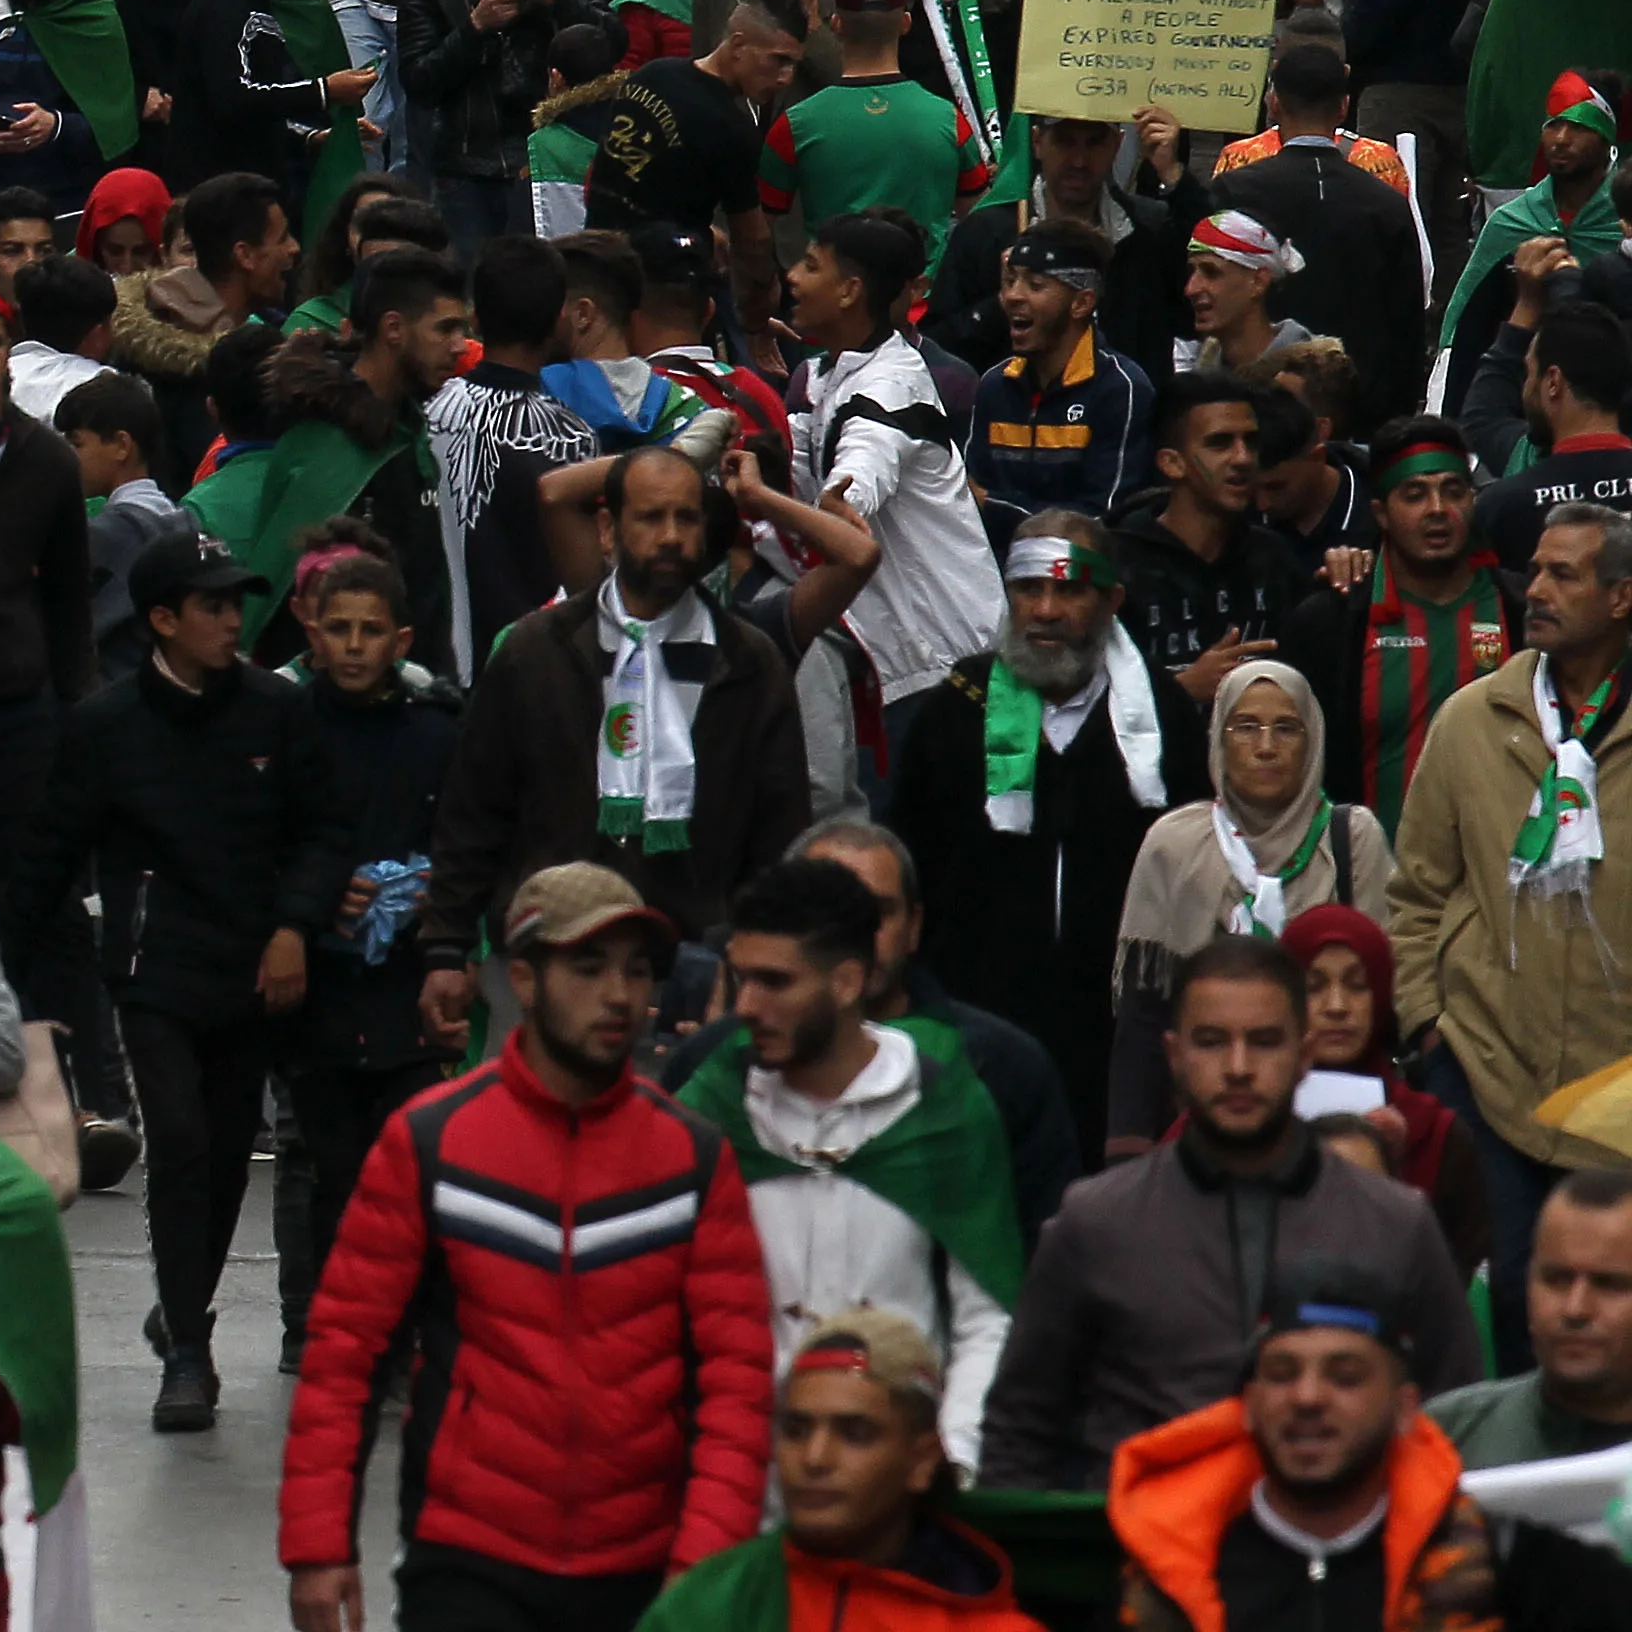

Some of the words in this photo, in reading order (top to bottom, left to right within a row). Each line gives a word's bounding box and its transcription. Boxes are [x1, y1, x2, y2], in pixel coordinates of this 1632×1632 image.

[1143, 10, 1224, 28] PEOPLE
[1058, 51, 1156, 71] EVERYBODY
[1227, 60, 1252, 72] GO
[616, 80, 683, 148] NIMATION
[1535, 482, 1585, 506] PRL
